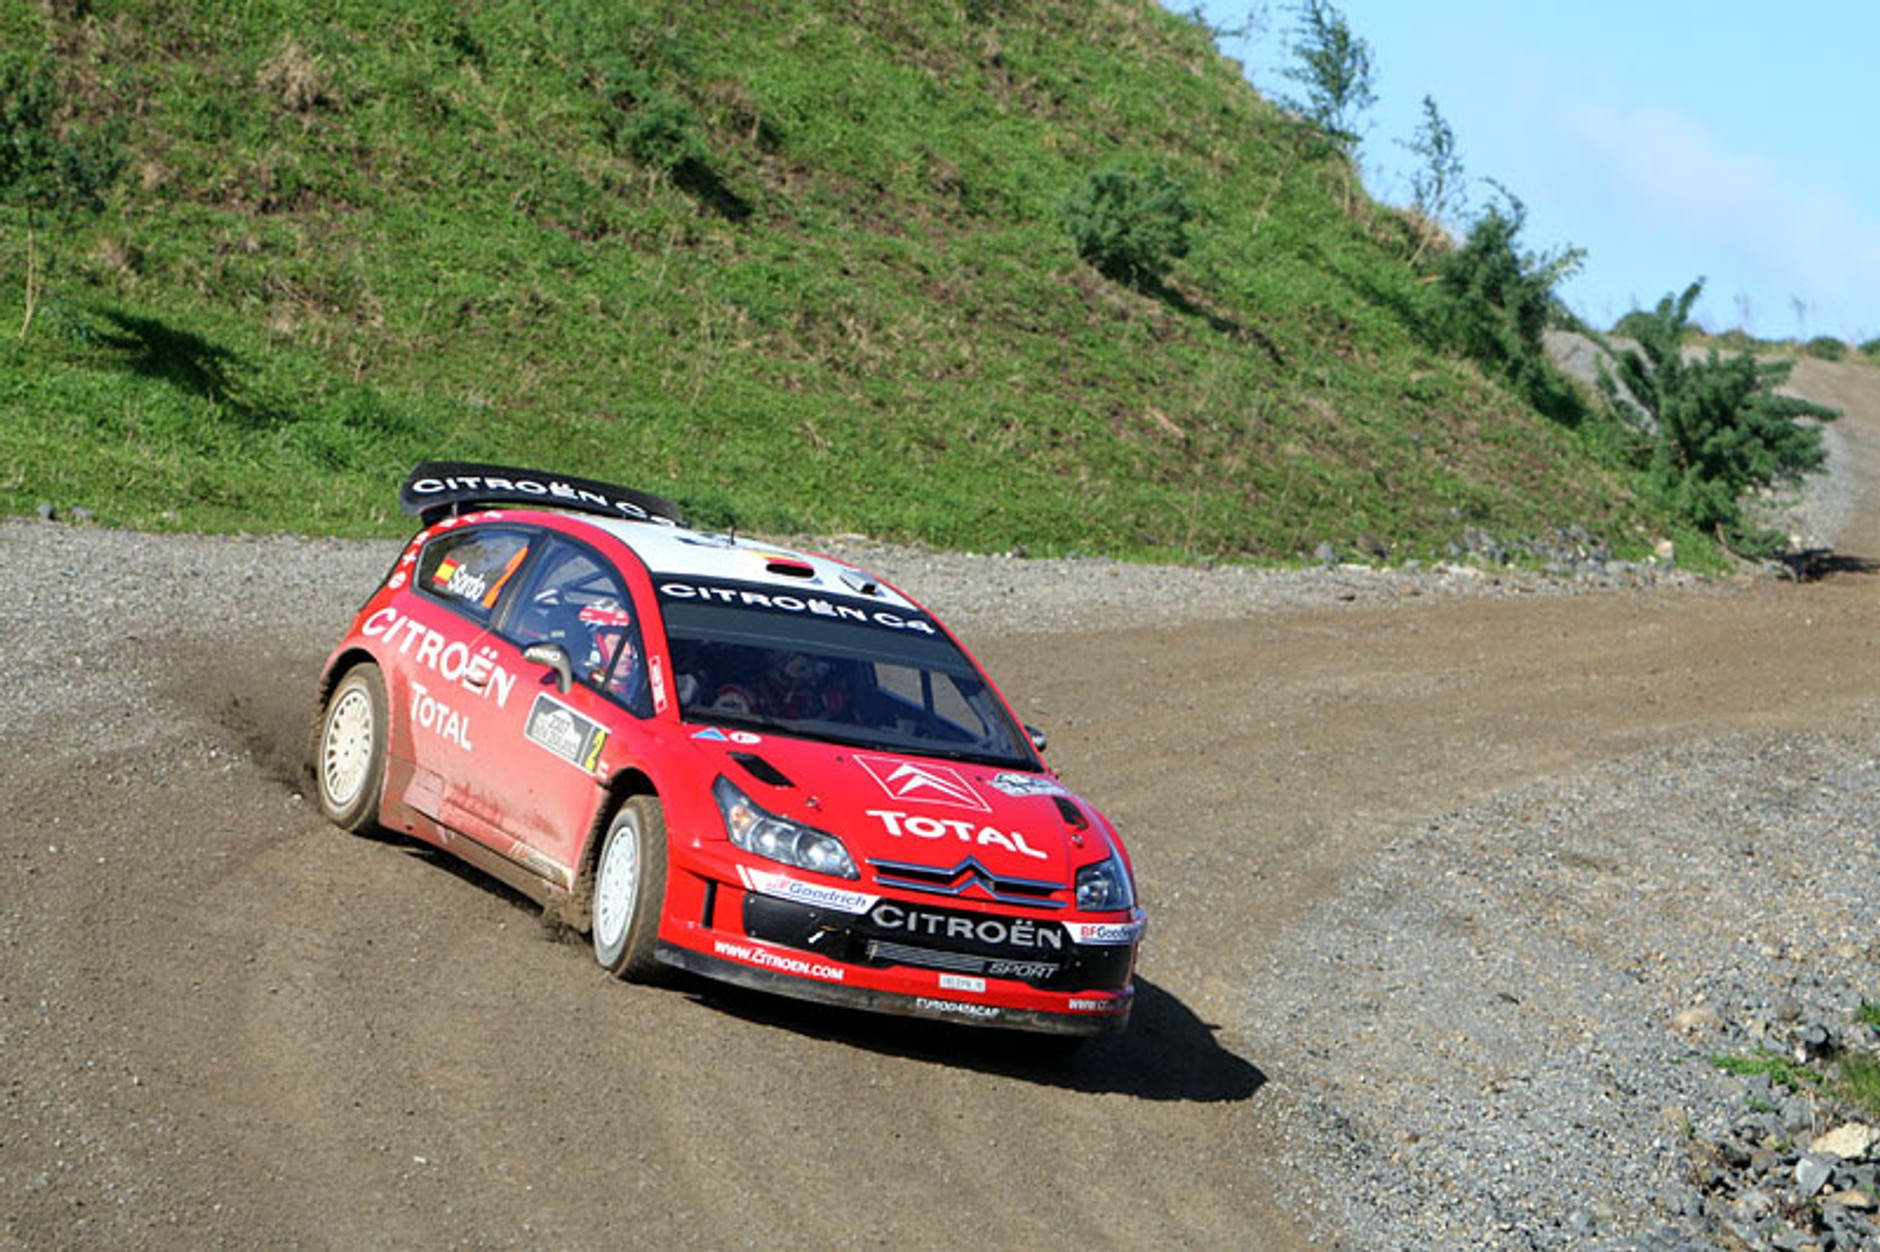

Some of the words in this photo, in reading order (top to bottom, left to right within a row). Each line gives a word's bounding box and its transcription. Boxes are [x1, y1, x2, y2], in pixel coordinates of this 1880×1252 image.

[413, 477, 607, 506] CITROËN
[447, 564, 486, 602] Sordo
[660, 583, 869, 622] CITROËN
[873, 613, 935, 634] C4
[361, 607, 517, 707] CITROËN
[410, 682, 472, 751] TOTAL
[584, 730, 606, 771] 2
[866, 810, 1047, 859] TOTAL
[872, 903, 1062, 950] CITROËN
[989, 962, 1060, 979] SPORT
